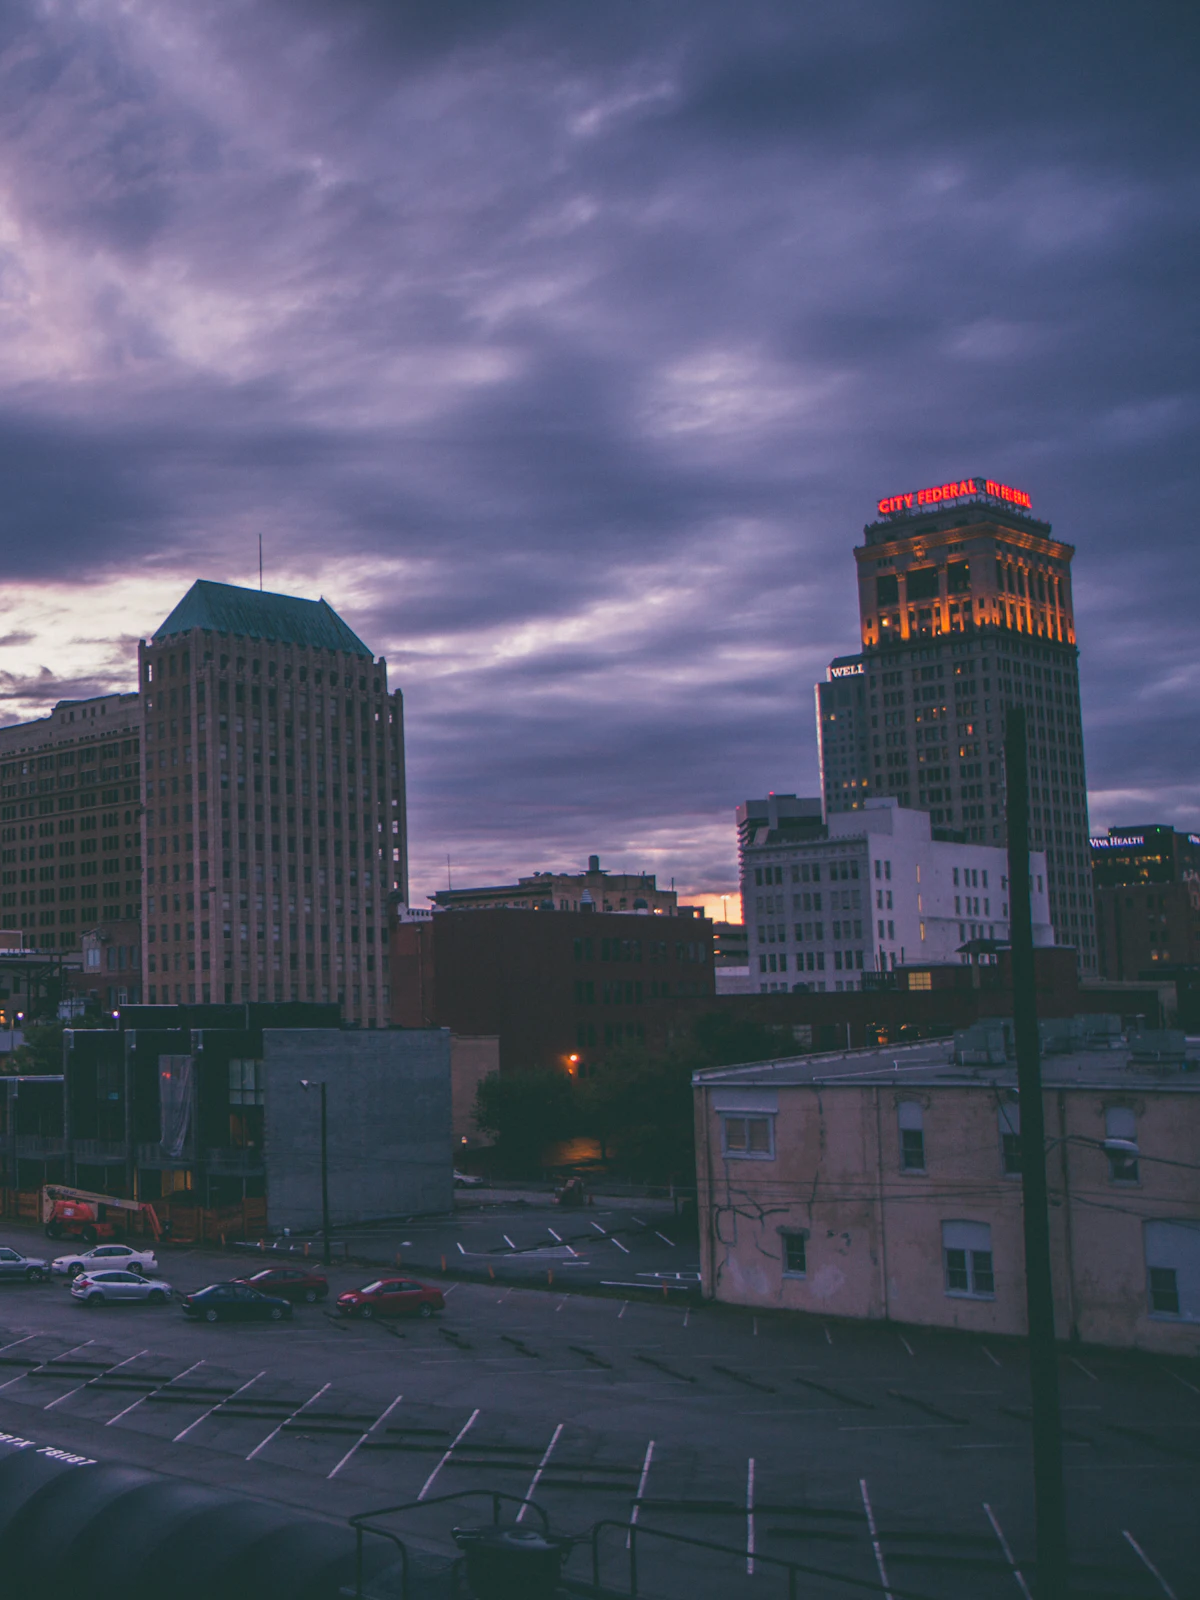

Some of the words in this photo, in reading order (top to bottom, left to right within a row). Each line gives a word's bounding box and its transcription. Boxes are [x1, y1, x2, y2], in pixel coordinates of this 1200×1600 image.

[878, 493, 914, 514] CITY
[917, 478, 978, 505] FEDERAL
[1110, 835, 1144, 846] HEALTH
[36, 1446, 98, 1466] 781187
